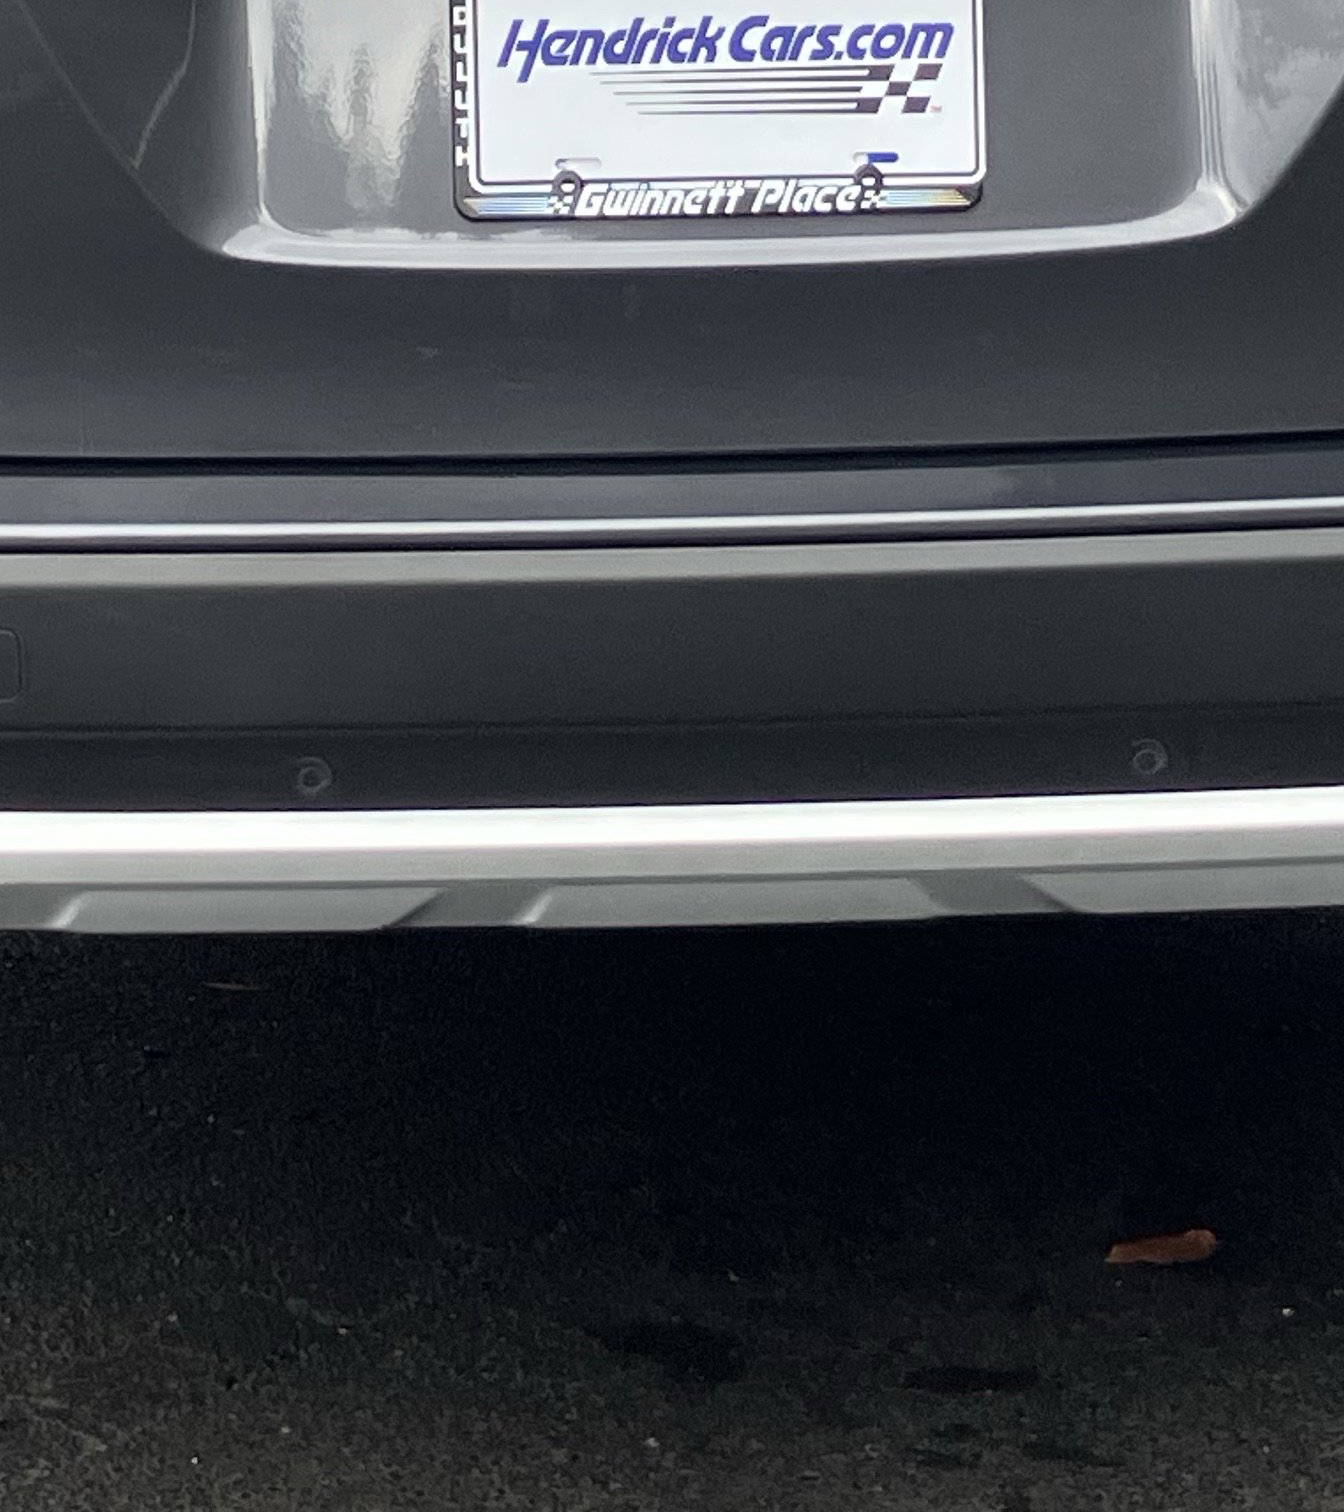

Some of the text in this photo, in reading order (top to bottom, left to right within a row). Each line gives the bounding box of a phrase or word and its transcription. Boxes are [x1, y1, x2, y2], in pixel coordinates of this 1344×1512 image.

[497, 15, 955, 83] HendrickCars.com
[574, 178, 859, 217] Gwinnett Place
